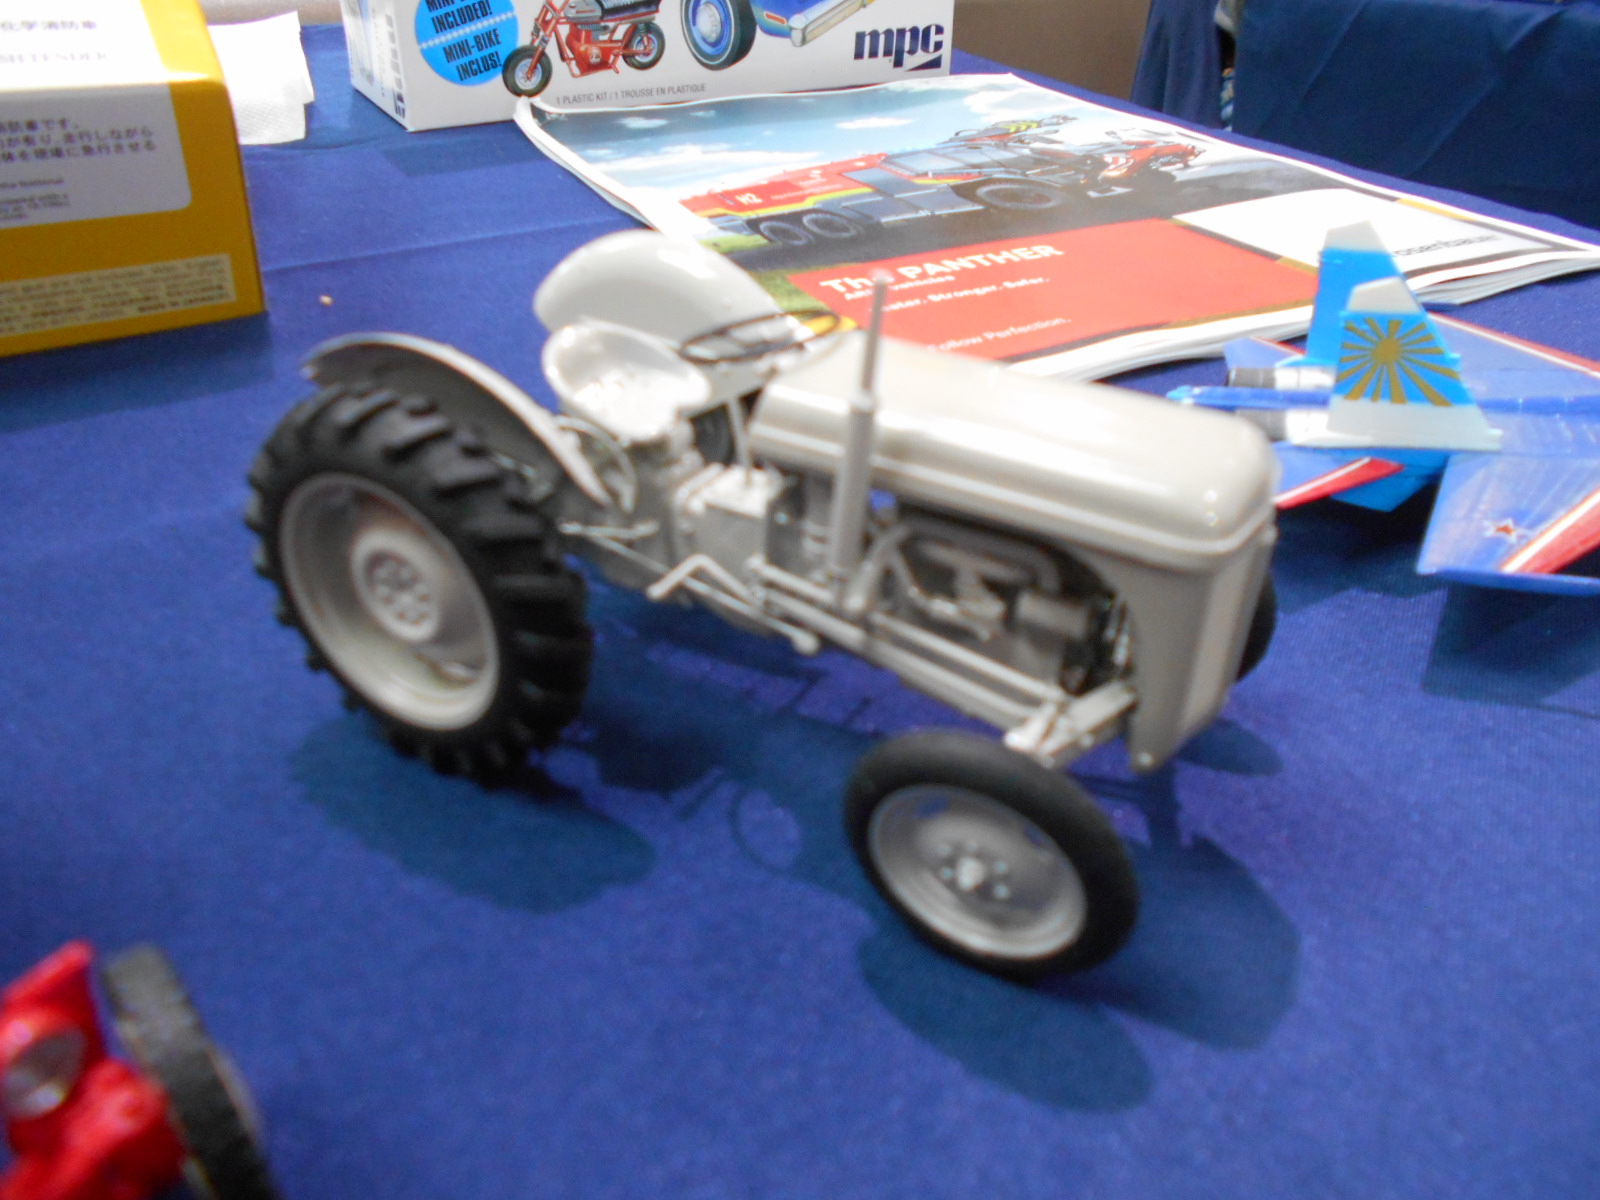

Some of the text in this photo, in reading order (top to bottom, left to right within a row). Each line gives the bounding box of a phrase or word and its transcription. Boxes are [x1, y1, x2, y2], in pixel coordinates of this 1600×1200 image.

[431, 0, 493, 34] INCLUDED!
[442, 28, 502, 63] MINI-BIKE
[853, 23, 945, 68] mpc
[456, 51, 503, 82] INCLUS!
[562, 92, 595, 104] PLASTIC
[595, 91, 608, 101] KIT
[621, 88, 654, 99] TROUSSE
[656, 87, 666, 96] EN
[667, 83, 707, 95] PLASTIQUE
[896, 245, 1065, 279] PANTHER
[868, 298, 928, 313] aster.
